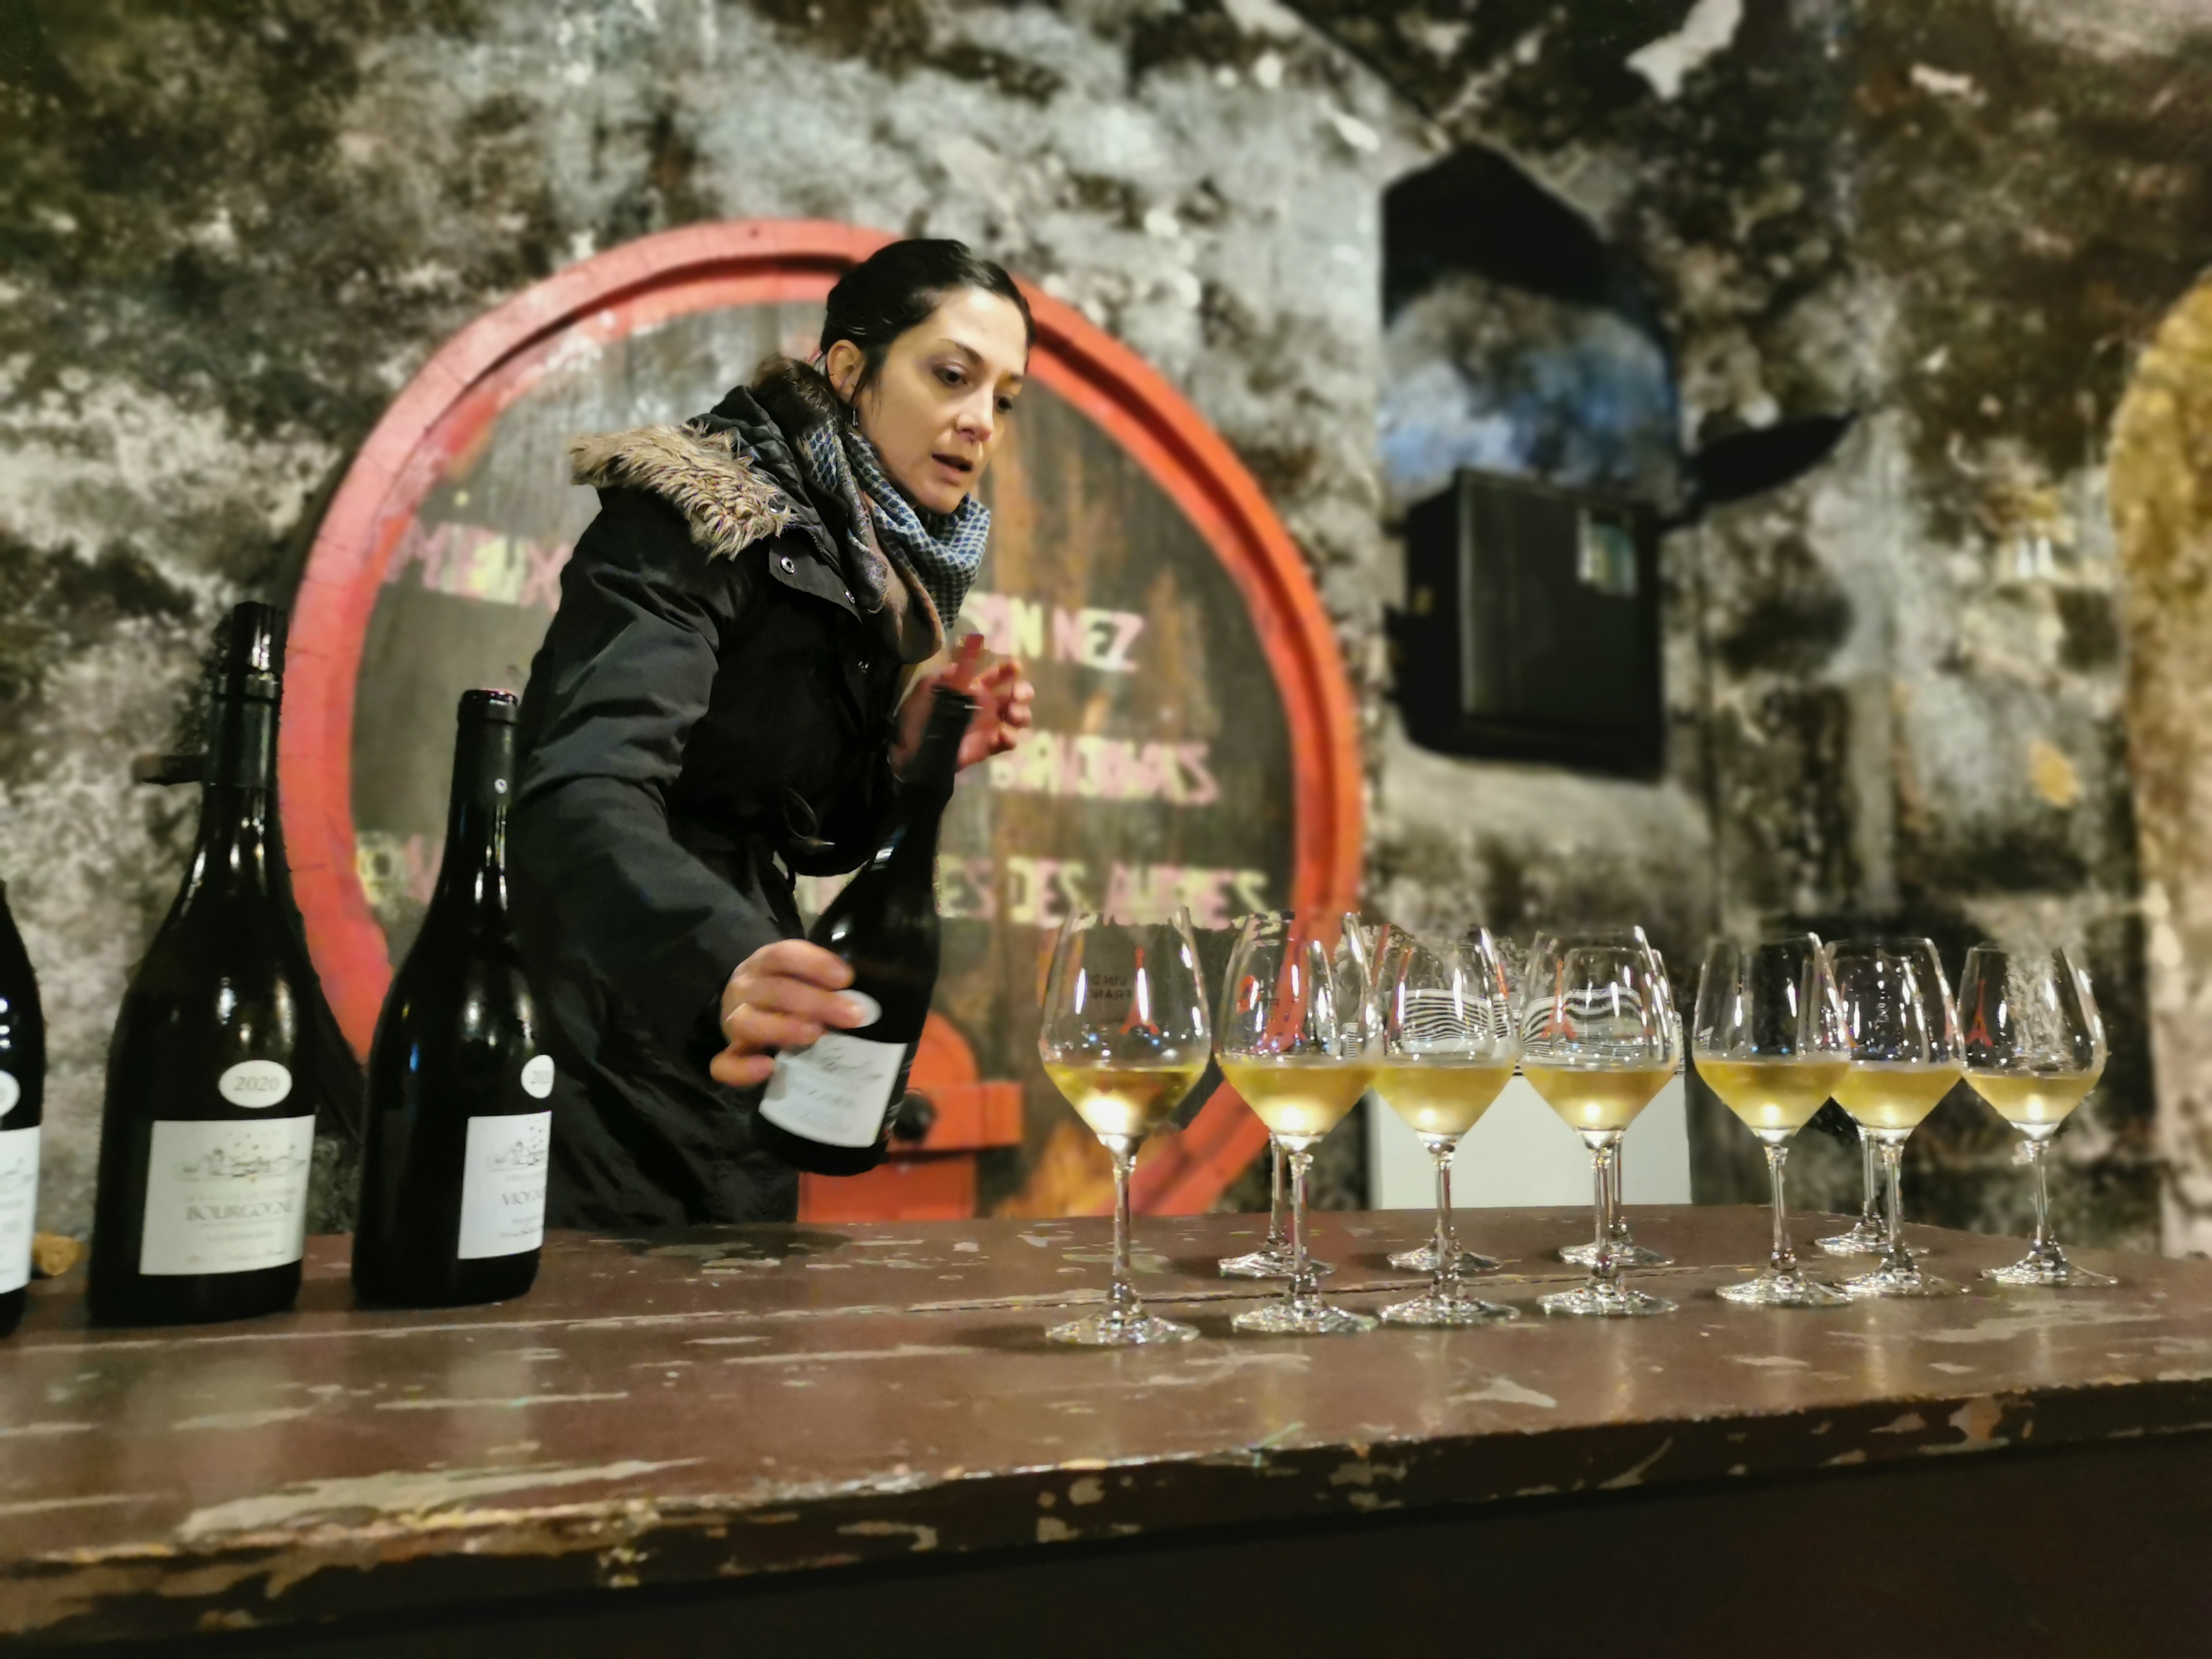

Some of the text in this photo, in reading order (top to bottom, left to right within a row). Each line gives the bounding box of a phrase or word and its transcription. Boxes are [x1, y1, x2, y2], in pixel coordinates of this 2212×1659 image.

[1052, 606, 1145, 672] NEZ
[1007, 855, 1098, 931] DES
[233, 1076, 281, 1092] 2020
